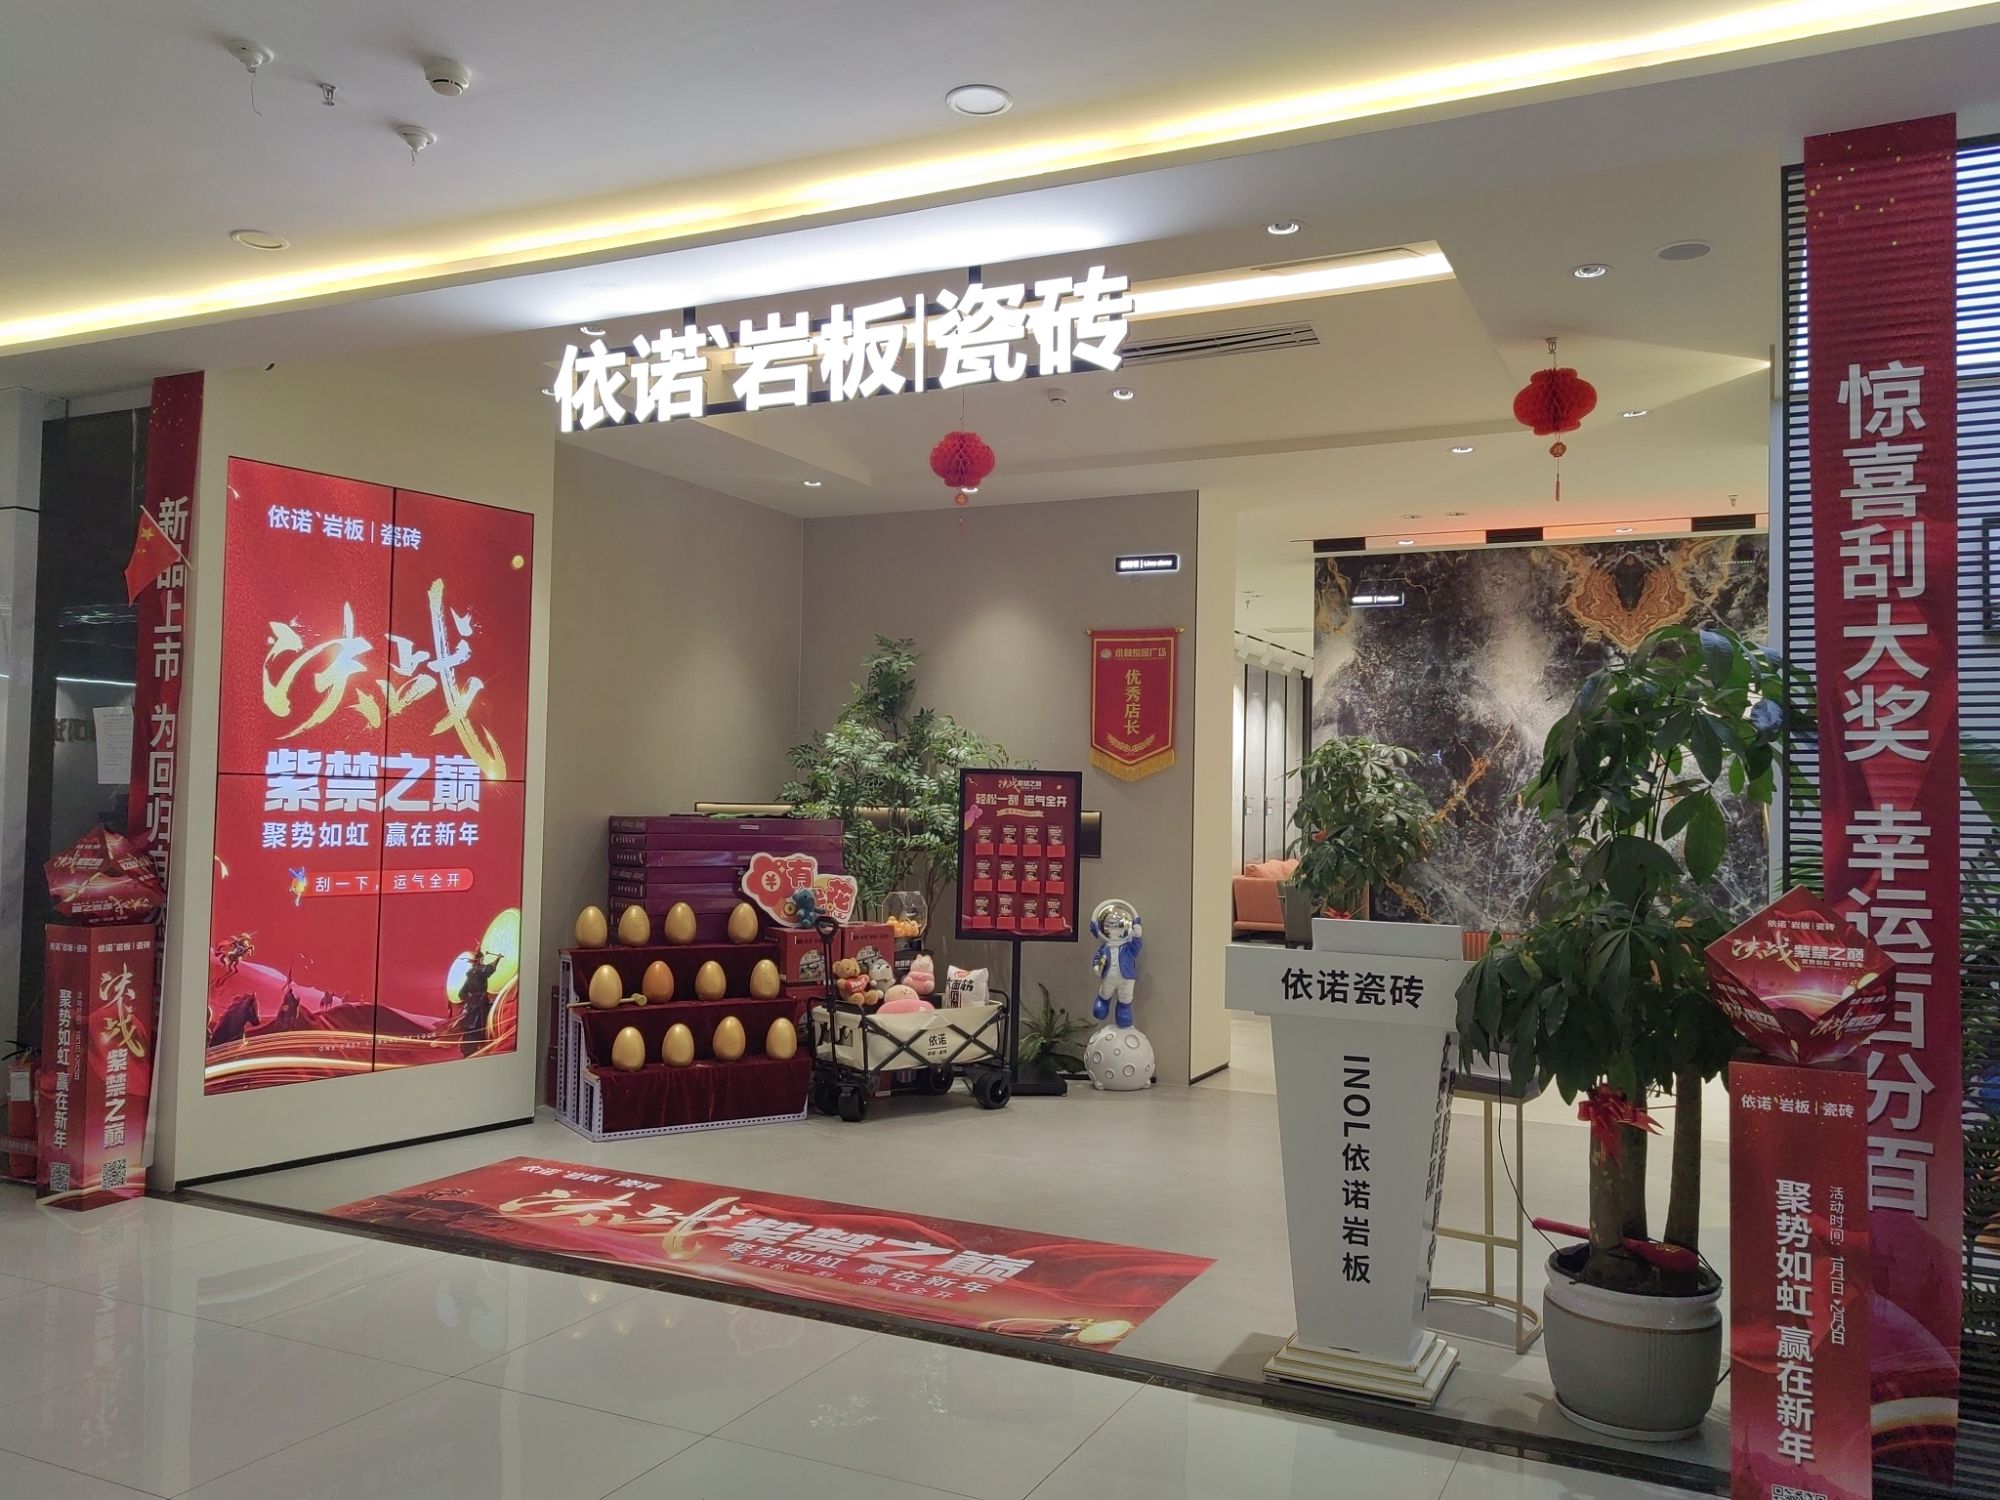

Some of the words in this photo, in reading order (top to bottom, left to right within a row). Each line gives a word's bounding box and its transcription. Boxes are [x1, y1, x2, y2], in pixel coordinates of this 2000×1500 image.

[154, 496, 188, 681] 新品上市
[1837, 361, 1931, 762] 惊喜刮大奖
[262, 578, 507, 782] 决战
[1124, 668, 1142, 735] 优秀店长
[264, 748, 481, 813] 紫禁之巅
[262, 821, 369, 849] 聚势如虹
[384, 821, 480, 847] 赢在新年
[392, 872, 460, 890] 运气全开
[1731, 930, 1801, 973] 决战
[1280, 967, 1425, 1010] 依诺瓷砖
[56, 989, 72, 1066] 聚势如虹
[104, 1048, 129, 1149] 紫禁之巅
[714, 1217, 1035, 1284] 紫禁之巅
[720, 1241, 848, 1270] 聚势如虹
[855, 1262, 993, 1294] 赢在新年
[1775, 1178, 1814, 1318] 聚势如虹
[1775, 1324, 1815, 1465] 赢在新年
